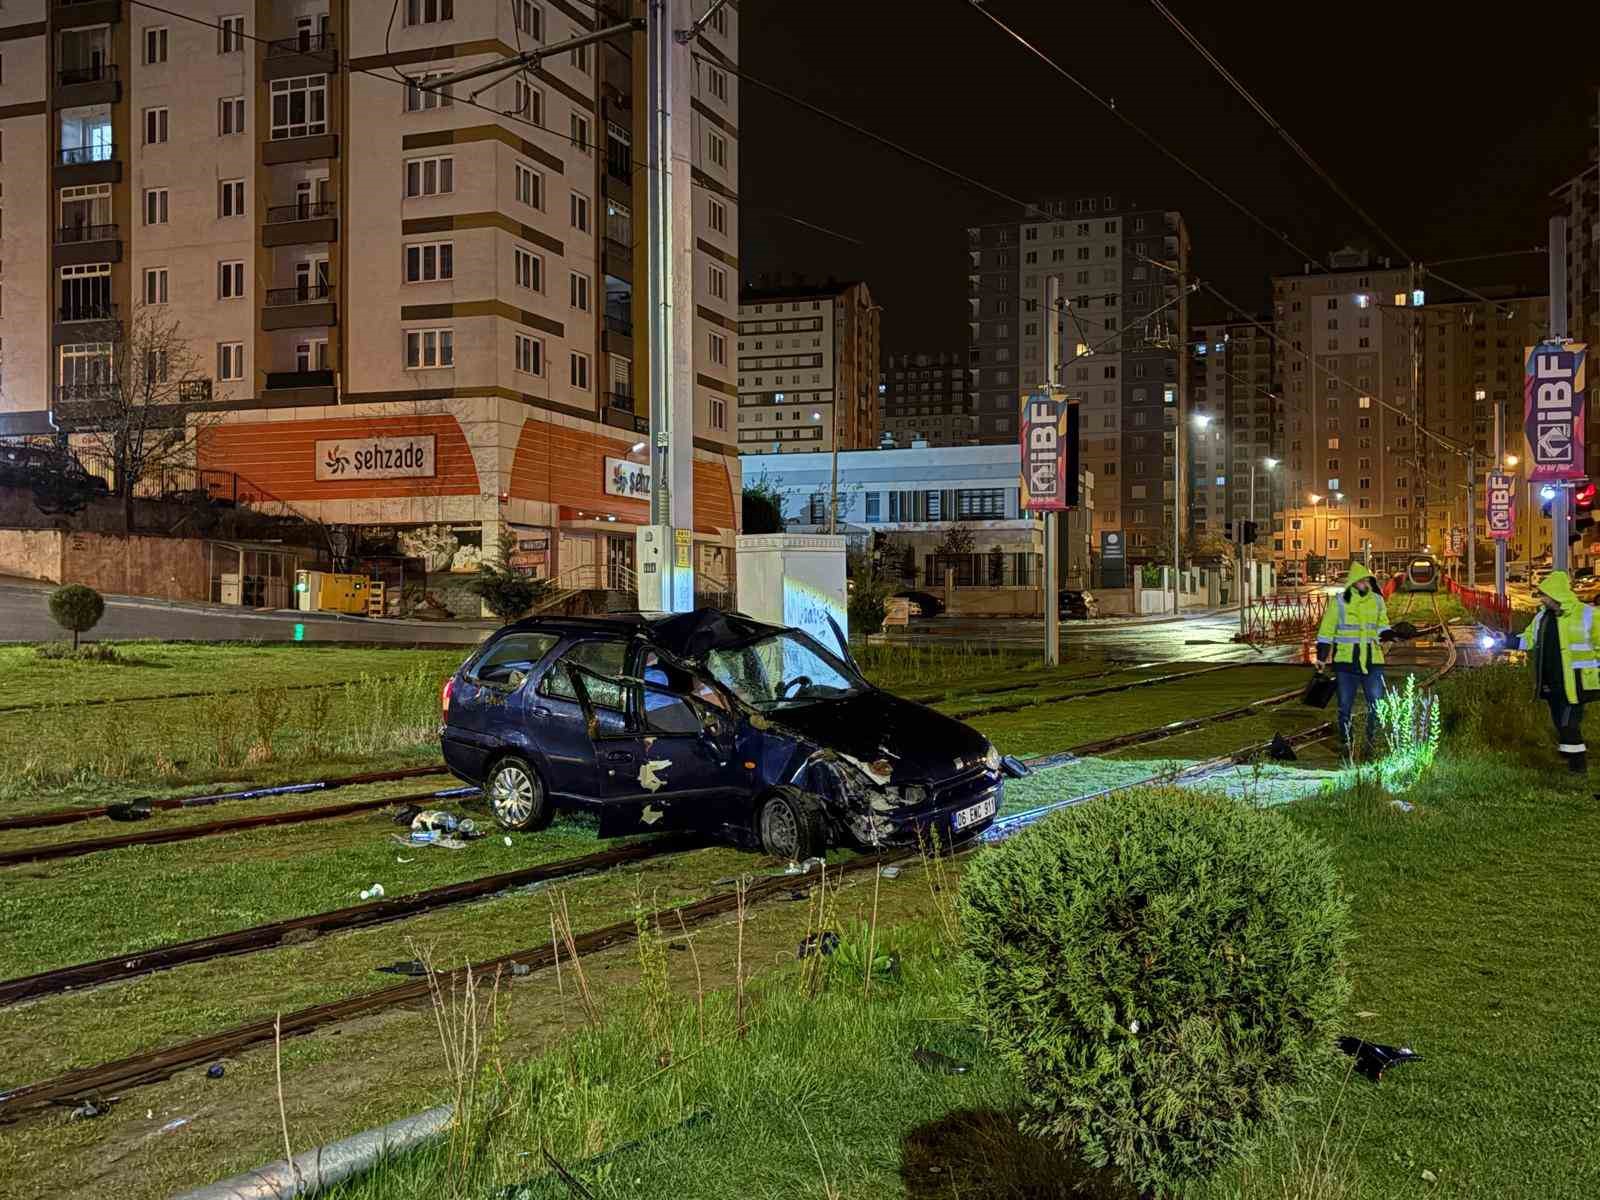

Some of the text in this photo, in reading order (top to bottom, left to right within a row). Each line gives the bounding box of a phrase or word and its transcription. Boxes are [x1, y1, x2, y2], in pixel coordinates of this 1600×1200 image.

[354, 442, 424, 473] şehzade
[630, 467, 651, 495] şehz
[957, 811, 967, 826] 06
